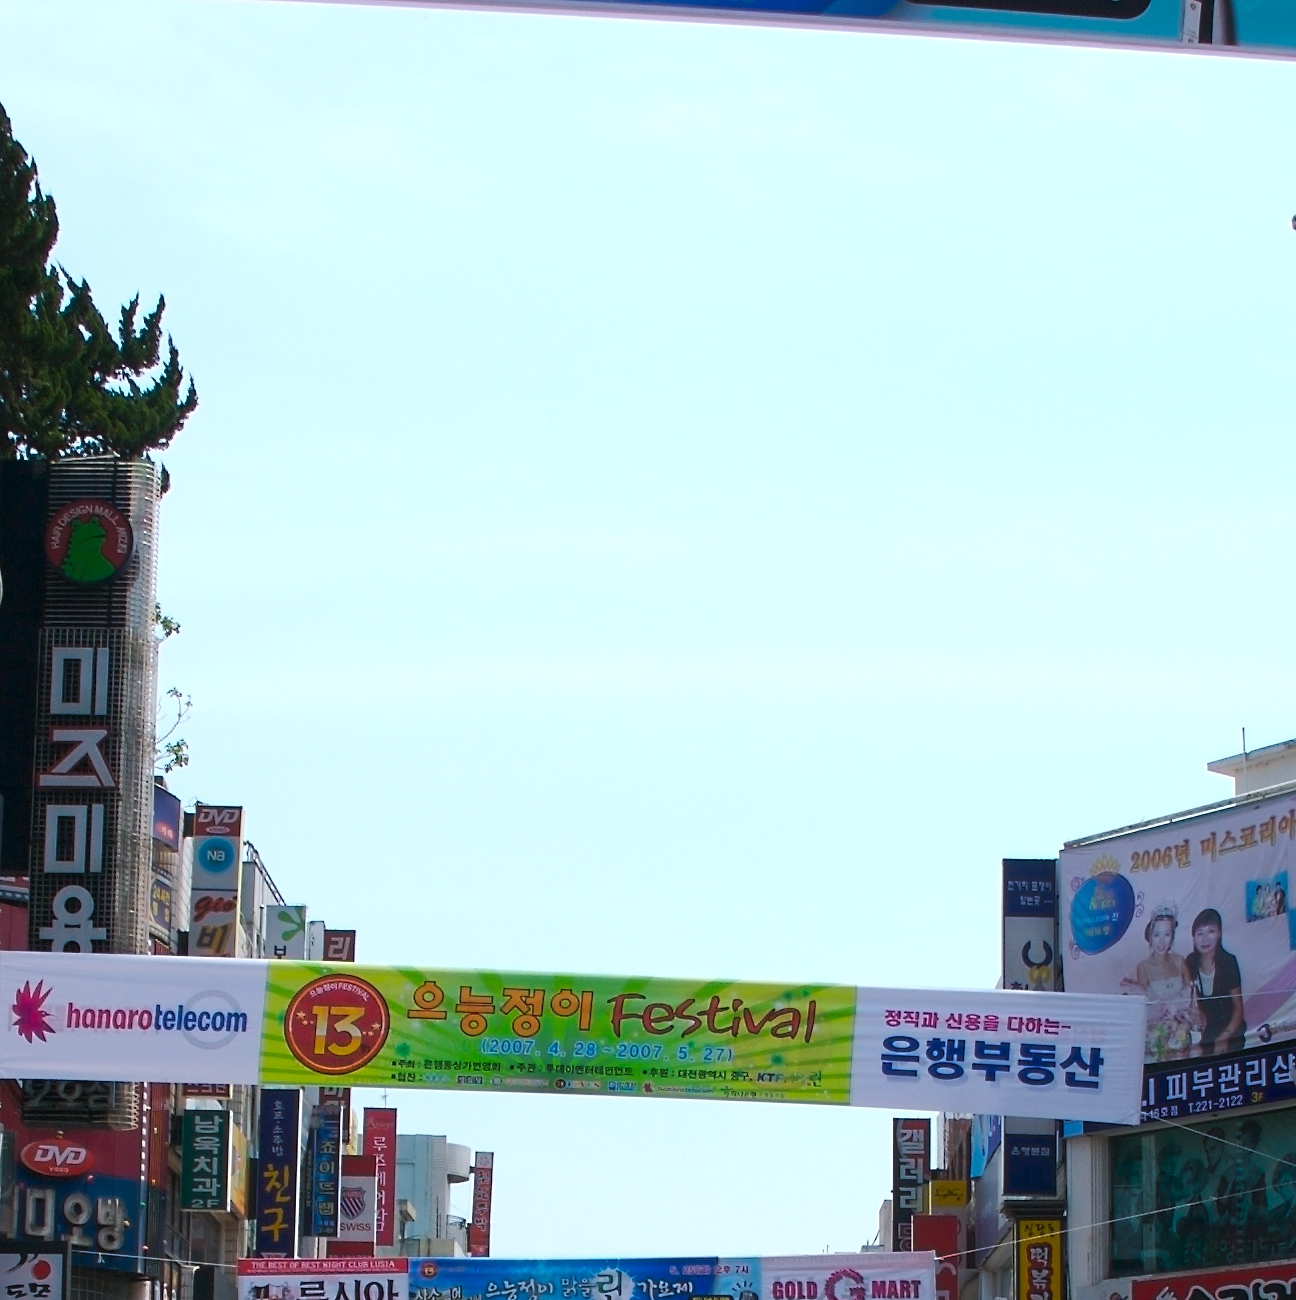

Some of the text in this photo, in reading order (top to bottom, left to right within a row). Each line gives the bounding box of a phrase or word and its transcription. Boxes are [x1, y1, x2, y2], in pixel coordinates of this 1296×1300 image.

[197, 808, 240, 826] DVD
[206, 849, 226, 862] Na
[1129, 843, 1192, 874] 2006년
[65, 1002, 248, 1033] hanarotelecom
[406, 980, 817, 1044] 으능정이 Festival
[883, 1009, 999, 1033] 정직과 신용을
[311, 1005, 366, 1056] 13
[480, 1038, 734, 1063] (2007. 4. 28 2007. 5. 27)
[879, 1035, 1105, 1090] 은행부동산
[677, 1069, 727, 1082] 대전광역시
[1165, 1053, 1296, 1102] 피부관리샵
[1187, 1095, 1244, 1114] T.221-2122
[33, 1144, 87, 1167] DVD
[192, 1115, 223, 1197] 남욱치과
[48, 1166, 70, 1174] VIDEO
[191, 1199, 221, 1209] 2F
[261, 1163, 291, 1243] 친구
[339, 1222, 372, 1232] SWISS
[251, 1261, 290, 1269] THE BEST
[735, 1264, 750, 1275] 7시
[771, 1280, 818, 1300] GOLD
[871, 1279, 922, 1300] MART
